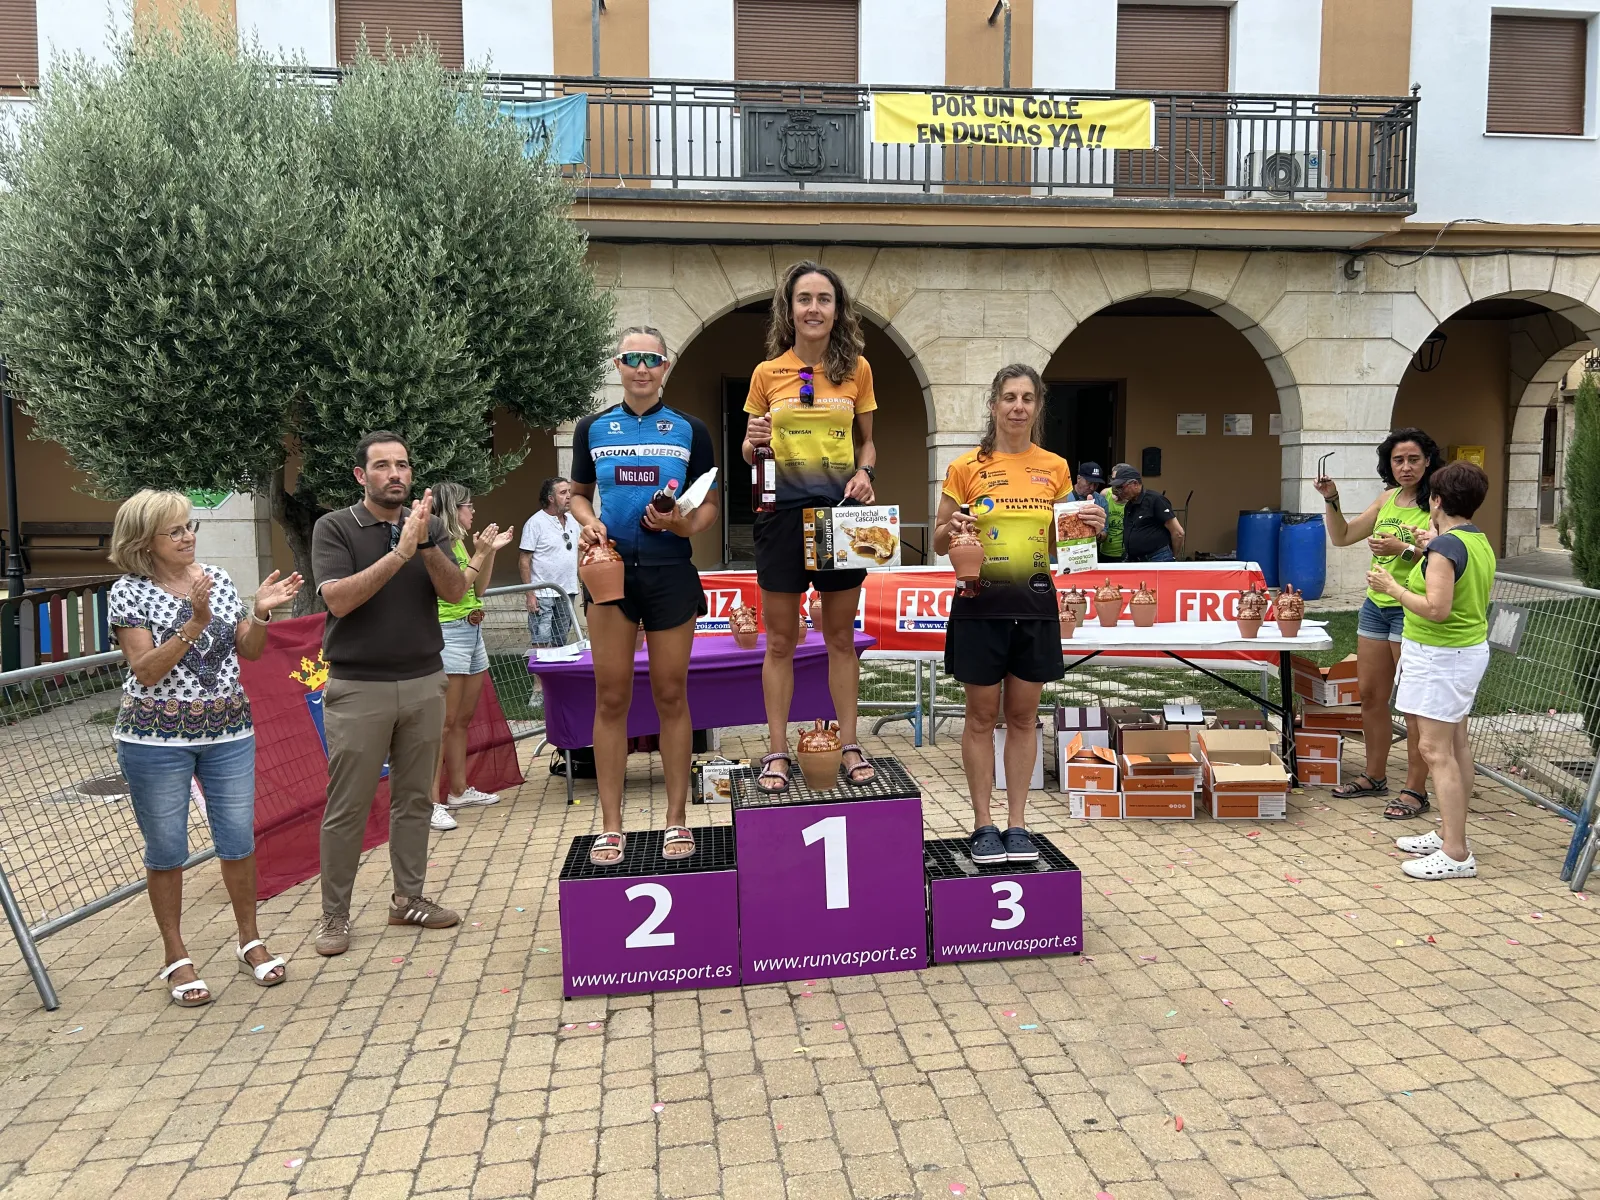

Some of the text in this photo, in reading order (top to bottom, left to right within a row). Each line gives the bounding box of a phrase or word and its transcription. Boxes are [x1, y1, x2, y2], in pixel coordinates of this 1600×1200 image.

[931, 94, 1083, 120] POR UN COLE
[916, 120, 1108, 149] EN DUEÑAS YA!!
[594, 448, 682, 461] LAGUNA DUERO
[835, 509, 879, 518] cordero lechal
[855, 515, 888, 523] cascajares
[825, 518, 833, 552] cascajares
[801, 815, 850, 910] 1
[624, 882, 676, 949] 2
[990, 880, 1026, 930] 3
[941, 935, 1078, 956] www.runvasport.es
[753, 946, 918, 972] www.runvasport.es
[571, 964, 733, 988] www.runvasport.es
